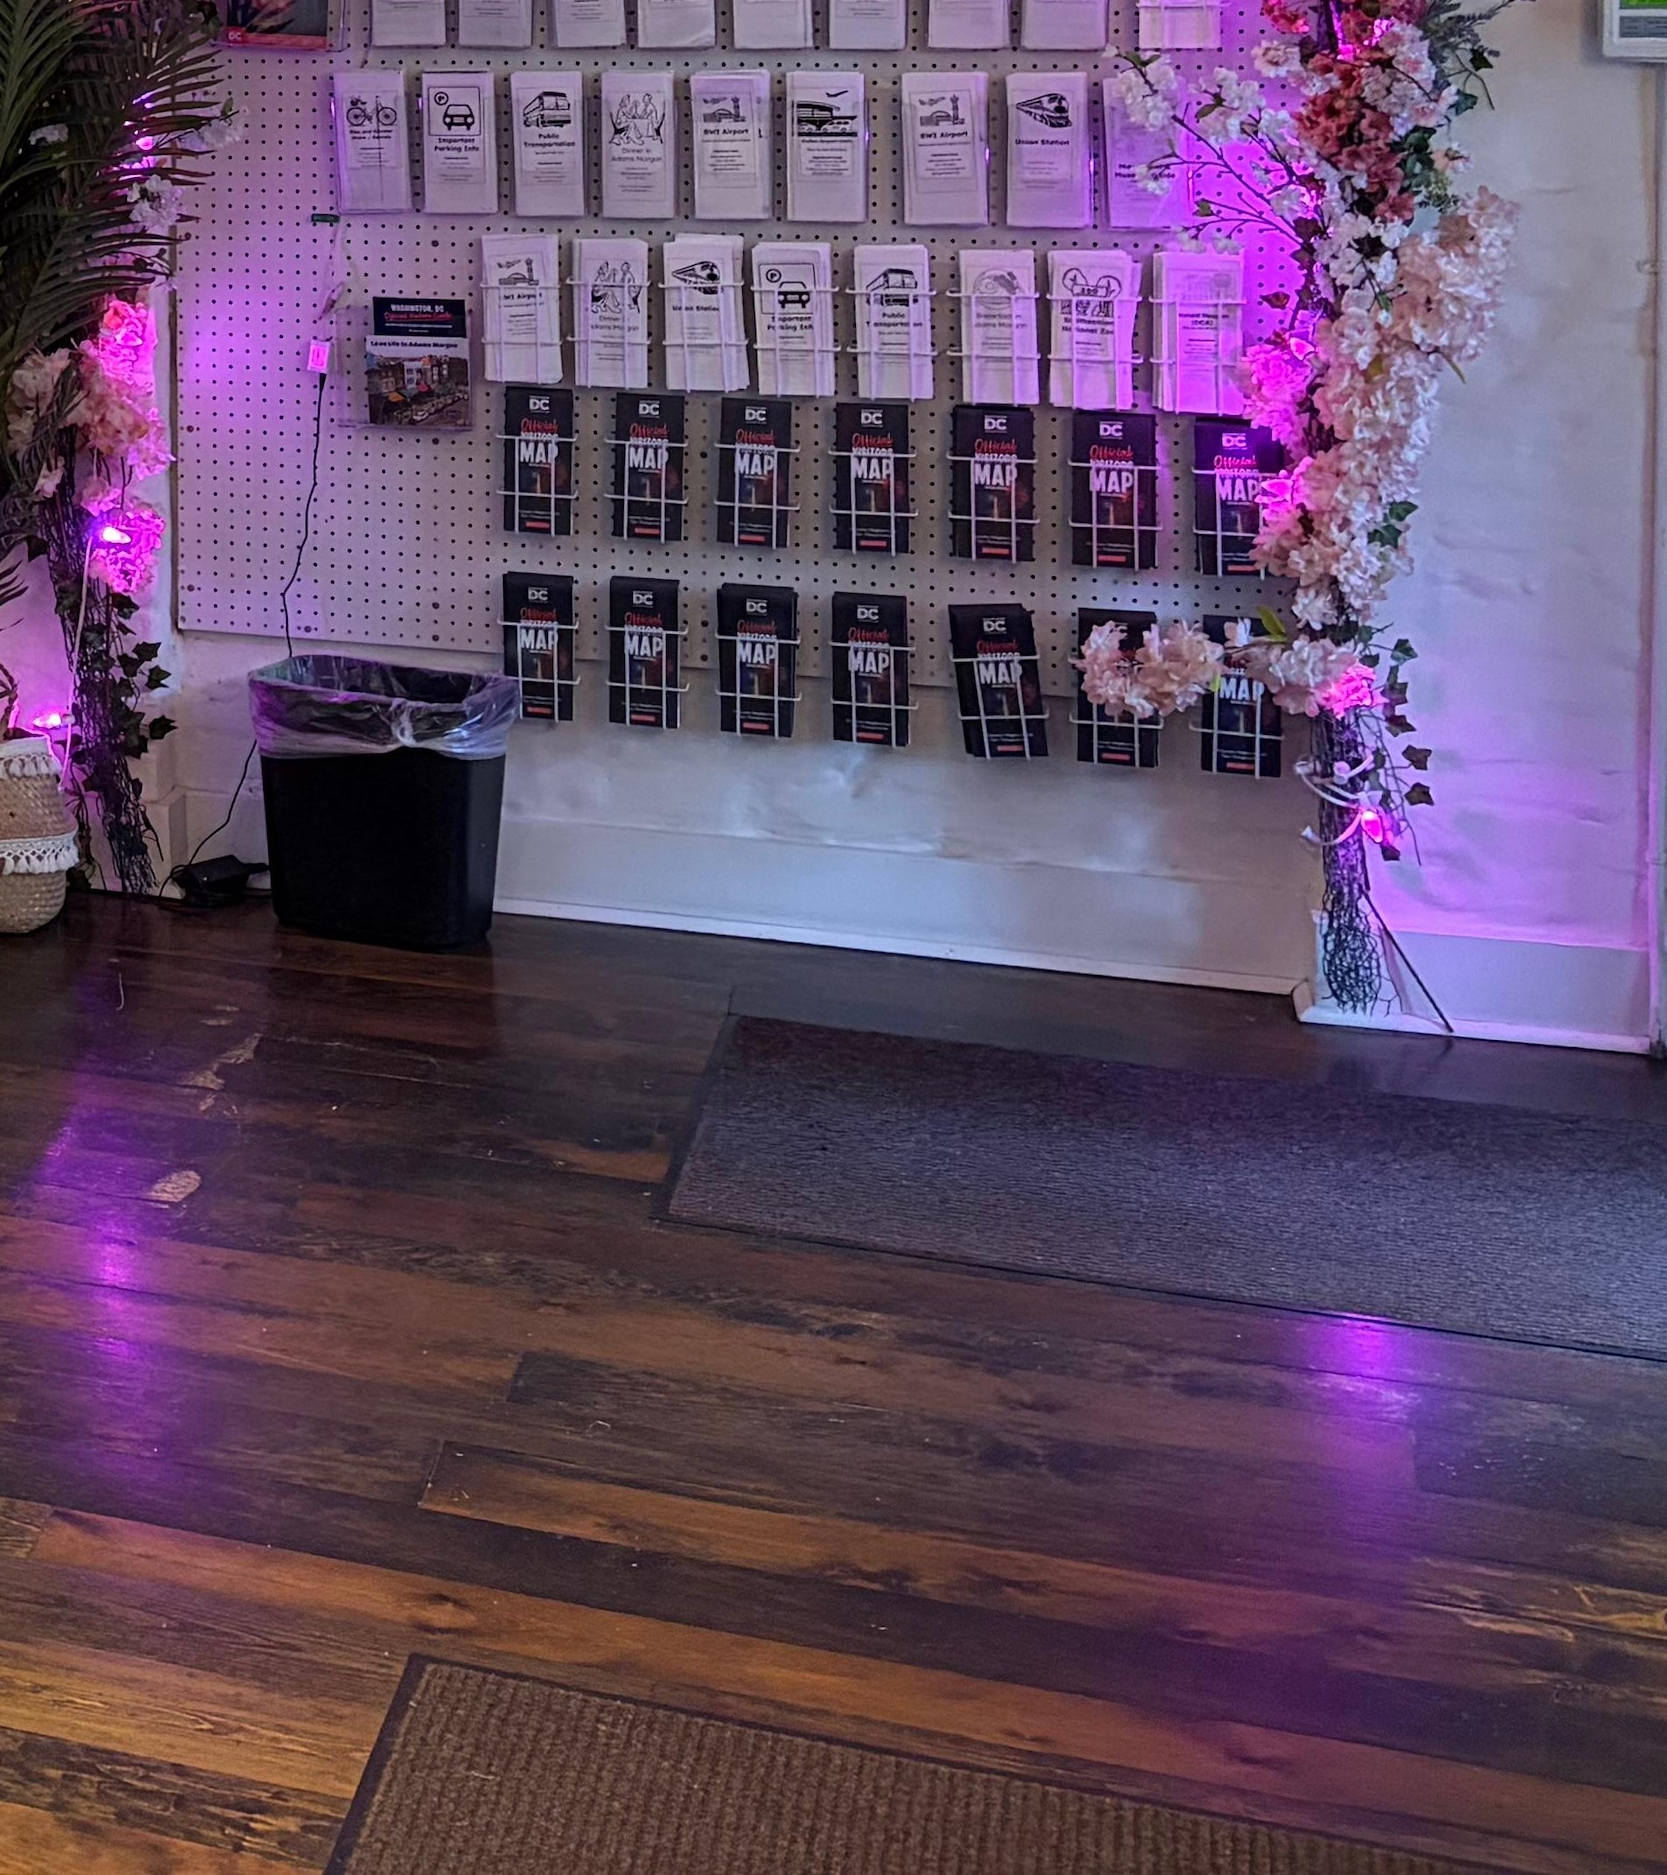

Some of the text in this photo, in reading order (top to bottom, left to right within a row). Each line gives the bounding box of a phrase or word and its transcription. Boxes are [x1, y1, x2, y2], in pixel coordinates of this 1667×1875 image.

[703, 128, 749, 136] BWI Airport
[941, 131, 968, 139] Airport
[529, 398, 550, 410] DC
[638, 403, 660, 415] DC
[745, 409, 767, 421] DC
[860, 413, 883, 424] DC
[984, 418, 1007, 430] DC
[1099, 424, 1123, 437] DC
[1221, 436, 1247, 447] DC
[520, 442, 558, 463] MAP
[629, 447, 669, 469] MAP
[735, 453, 775, 475] MAP
[852, 458, 893, 479] MAP
[974, 463, 1017, 486] MAP
[1089, 471, 1134, 493] MAP
[1217, 478, 1259, 501] MAP
[528, 590, 548, 600] DC
[632, 594, 654, 604] DC
[746, 602, 768, 613] DC
[857, 608, 879, 619] DC
[983, 620, 1006, 631] DC
[520, 629, 559, 650] MAP
[624, 635, 663, 657] MAP
[738, 642, 776, 664] MAP
[848, 650, 890, 673] MAP
[978, 663, 1022, 684] MAP
[1219, 677, 1265, 701] MAP
